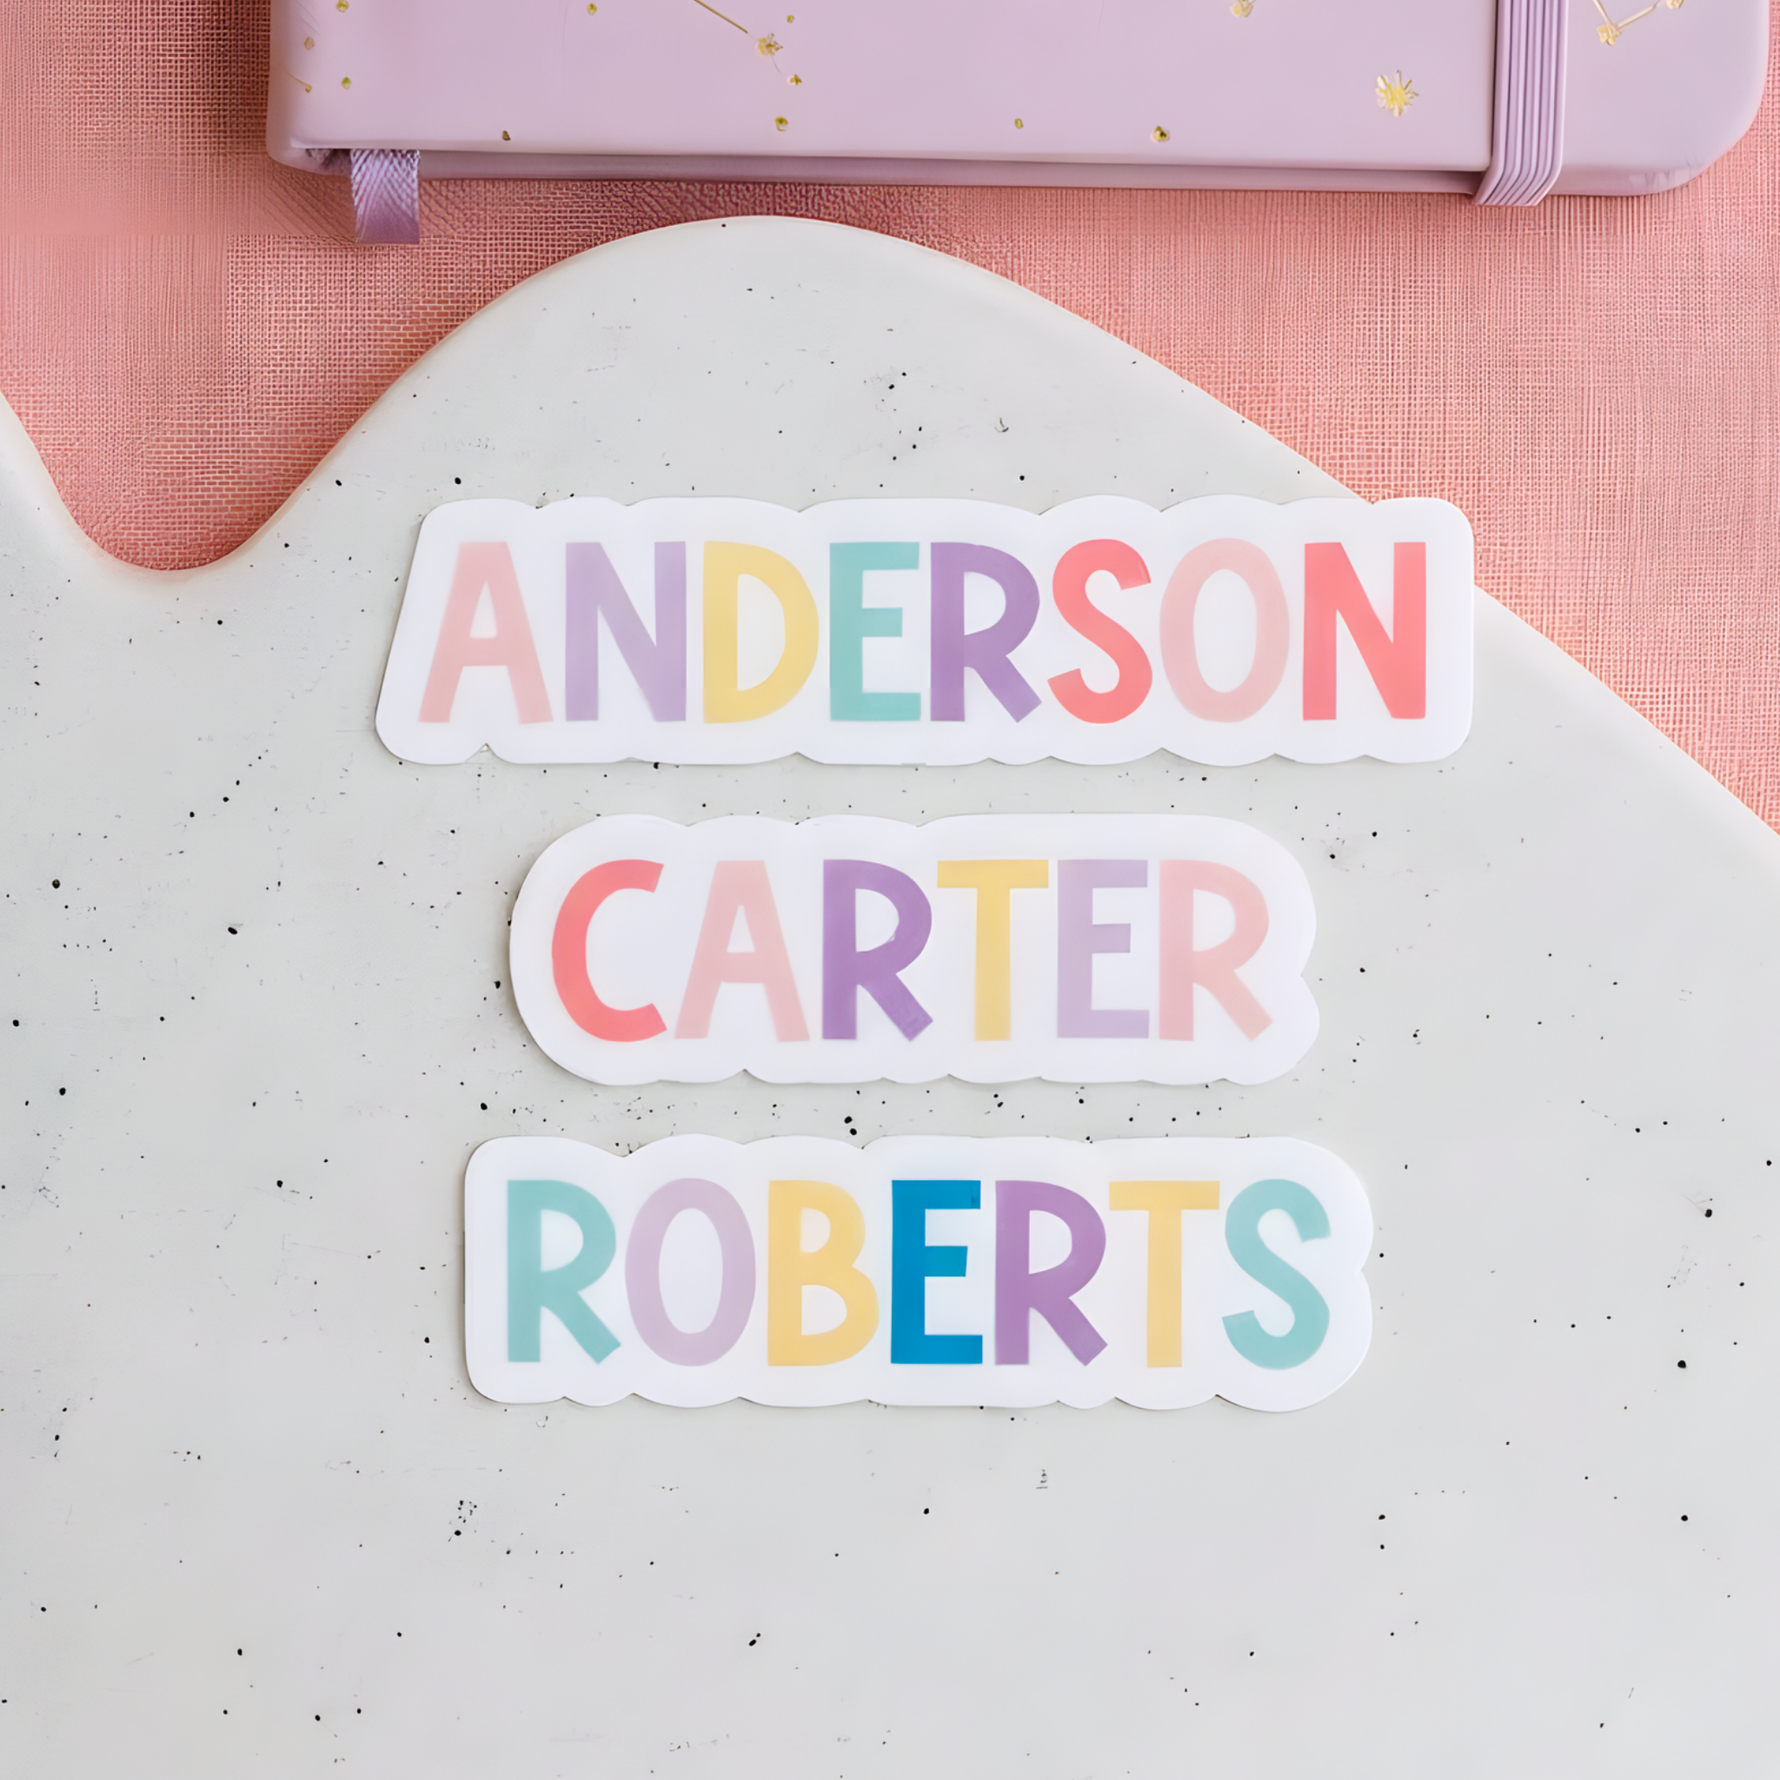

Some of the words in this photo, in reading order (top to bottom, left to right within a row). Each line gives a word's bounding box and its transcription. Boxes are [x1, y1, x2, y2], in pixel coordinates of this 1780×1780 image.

[419, 538, 1427, 725] ANDERSON
[550, 858, 1273, 1044] CARTER
[505, 1178, 1332, 1370] ROBERTS
